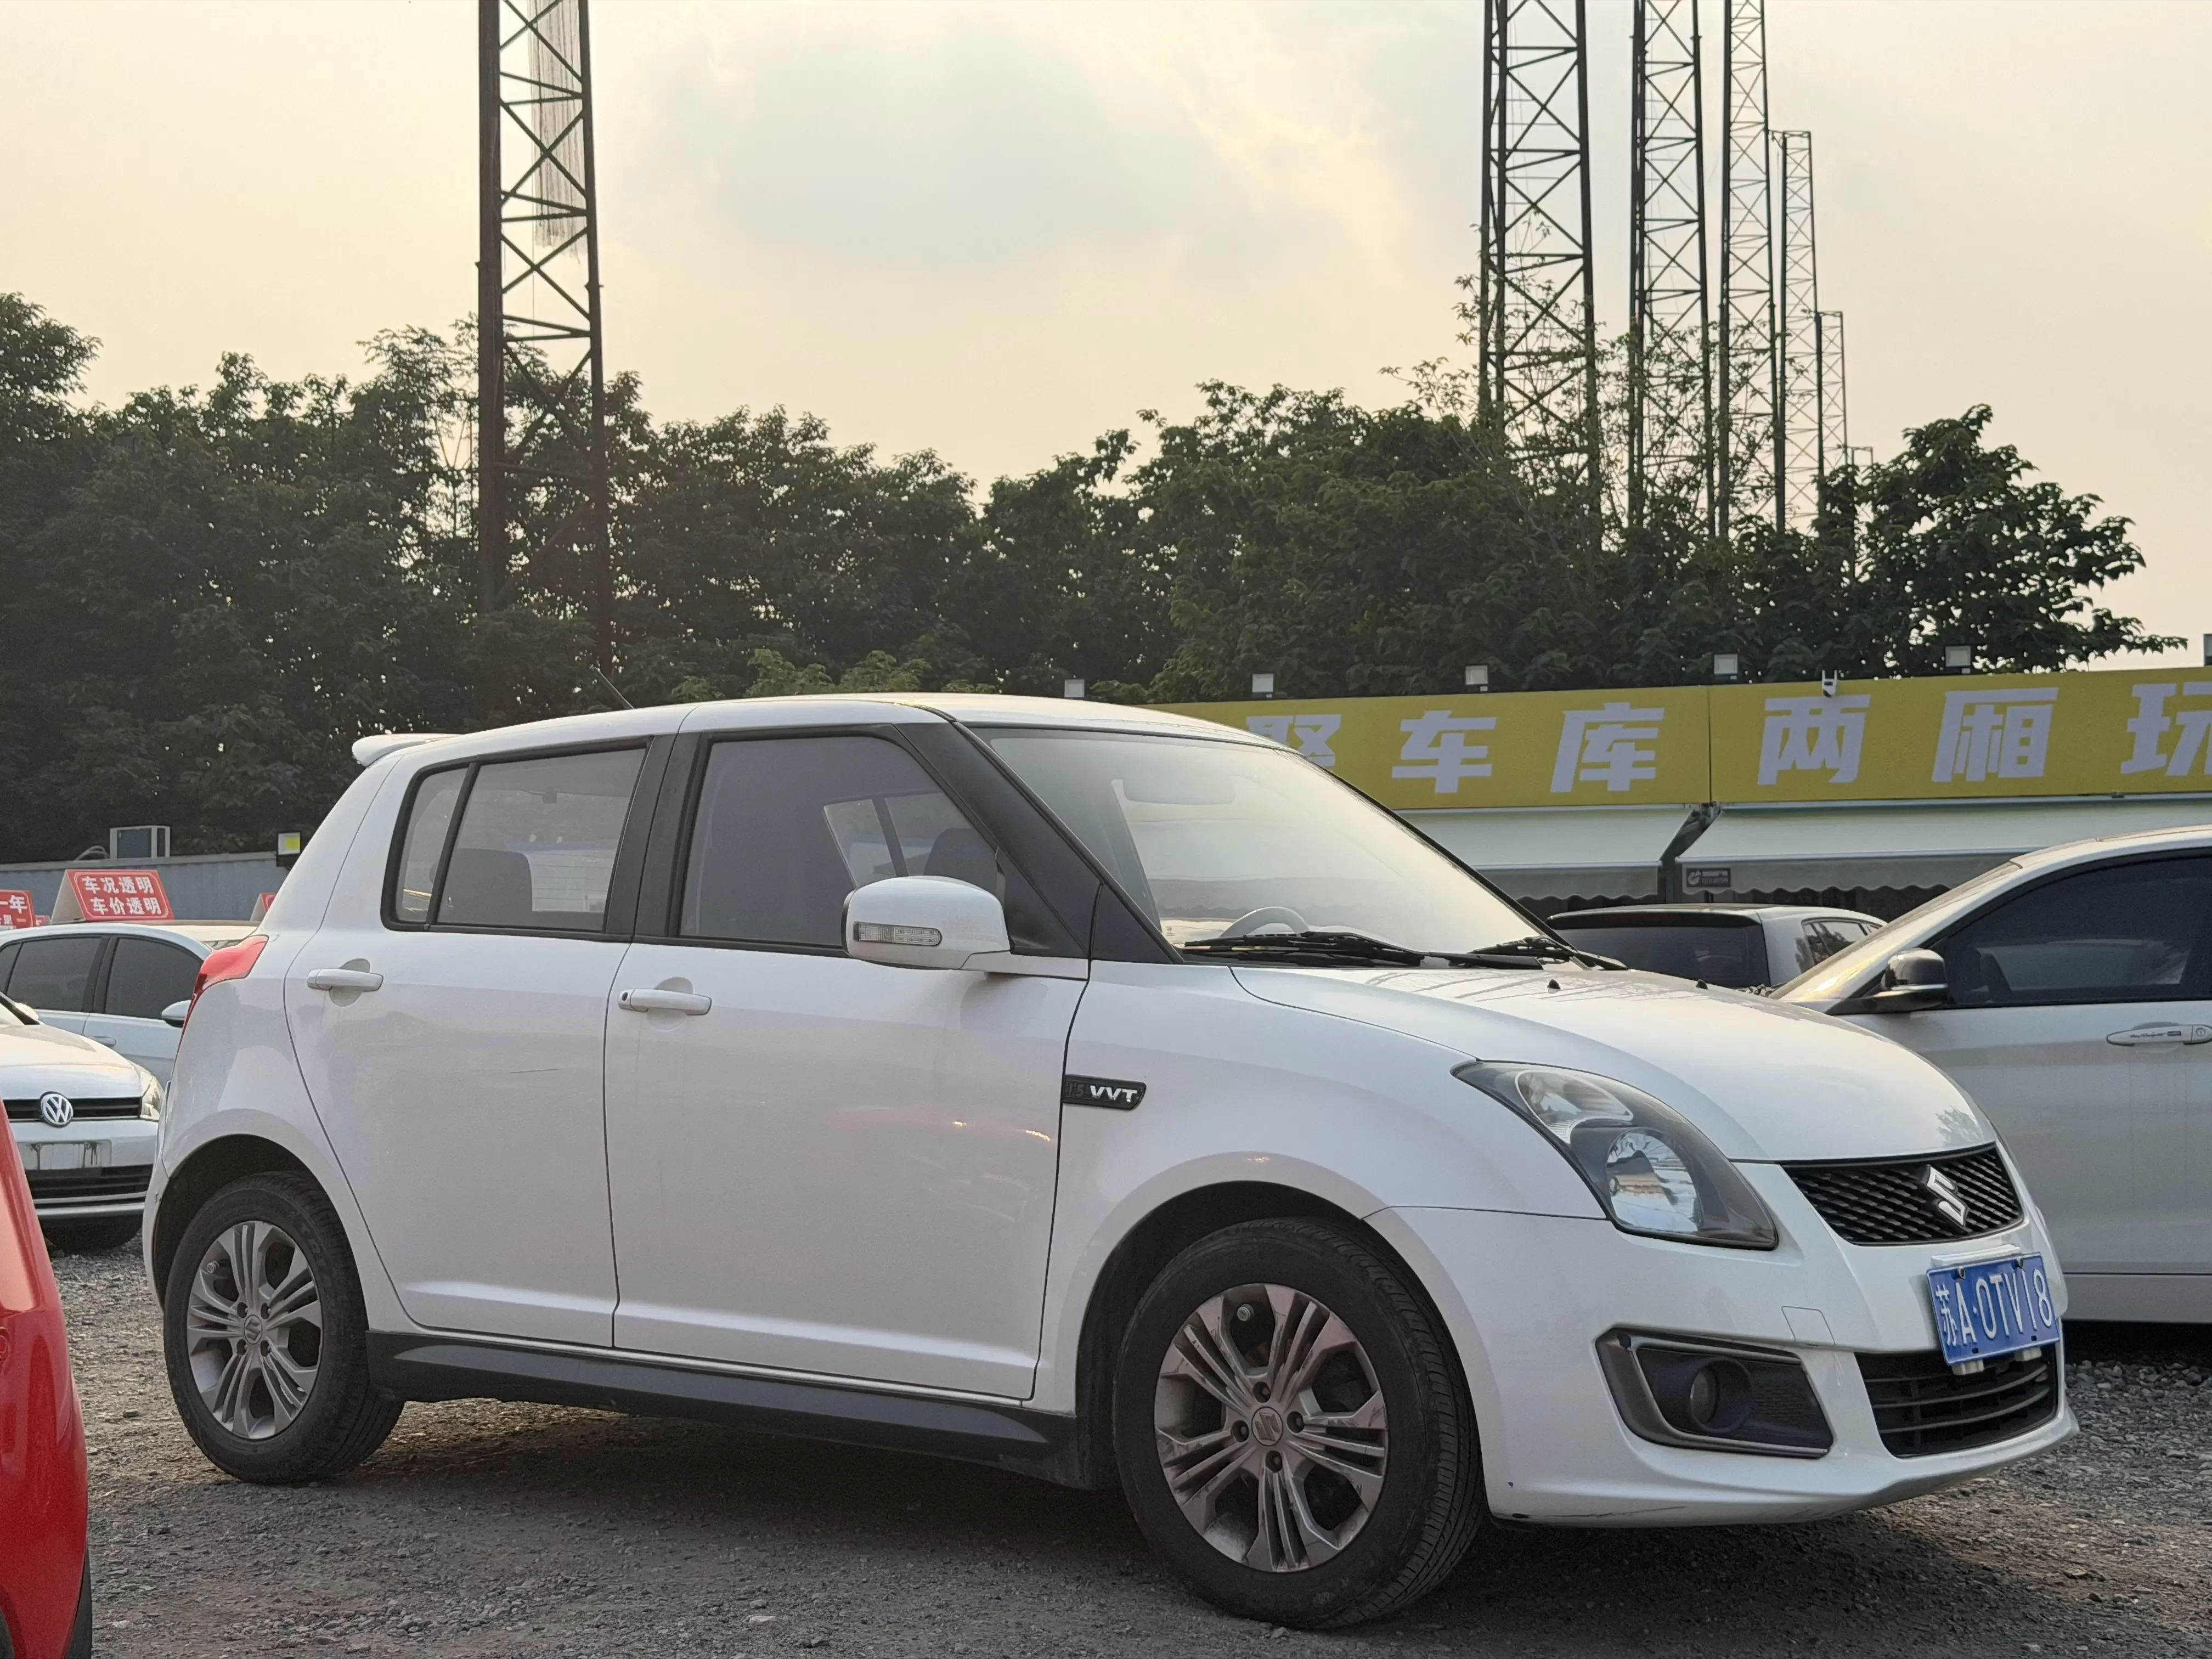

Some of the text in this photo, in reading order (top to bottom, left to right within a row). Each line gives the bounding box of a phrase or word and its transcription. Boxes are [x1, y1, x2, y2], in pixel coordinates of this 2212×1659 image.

[83, 876, 154, 894] 车况透明
[91, 897, 162, 915] 车价透明
[1090, 1085, 1138, 1102] VVT
